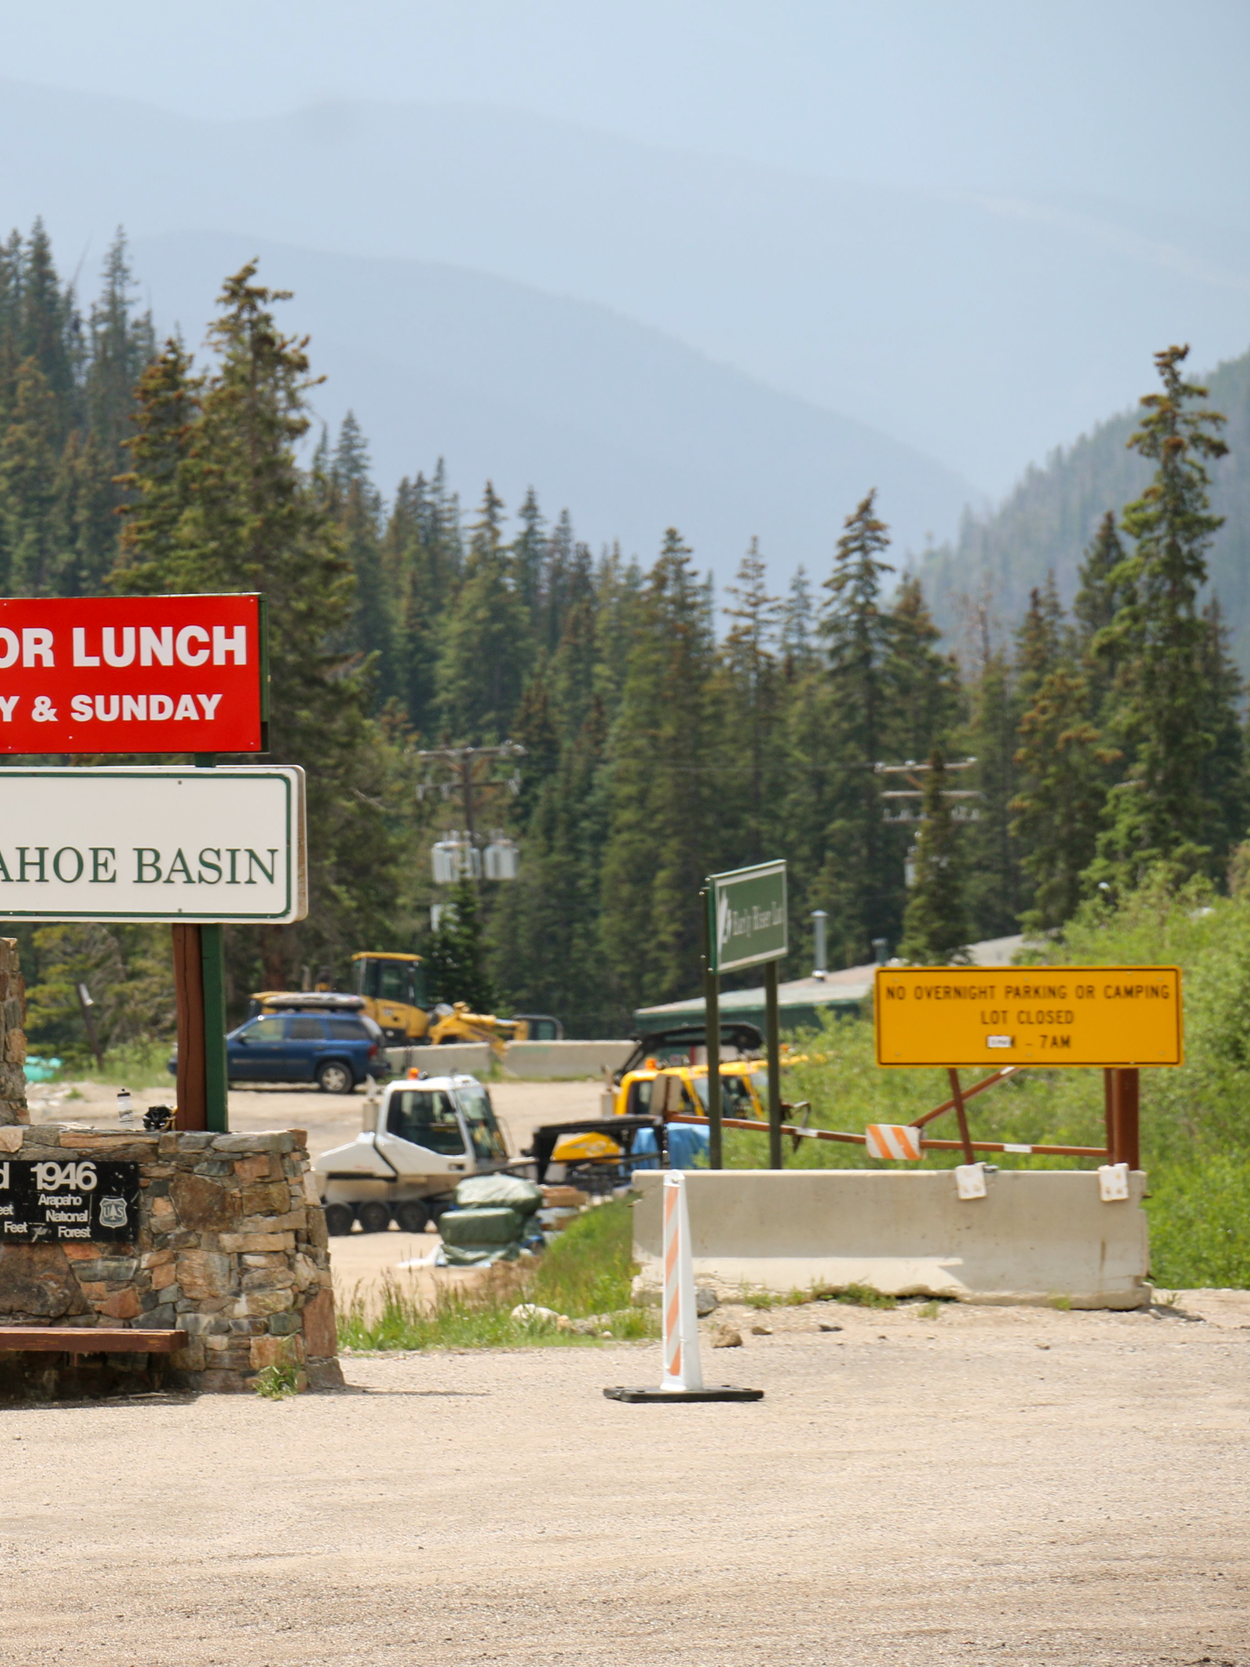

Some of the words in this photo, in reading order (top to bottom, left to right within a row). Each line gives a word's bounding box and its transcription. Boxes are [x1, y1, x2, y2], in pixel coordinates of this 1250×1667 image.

[72, 625, 247, 668] LUNCH
[31, 695, 59, 723] &
[70, 693, 223, 722] SUNDAY
[132, 847, 279, 885] BASIN
[886, 985, 906, 1000] NO
[914, 985, 996, 1000] OVERNIGHT
[1005, 985, 1067, 999] PARKING
[1076, 985, 1095, 999] OR
[1104, 984, 1170, 999] CAMPING
[981, 1010, 1008, 1025] LOT
[1017, 1010, 1075, 1025] CLOSED
[1039, 1034, 1071, 1049] 7AM
[30, 1161, 98, 1191] 1946
[38, 1193, 83, 1207] Arapaho
[46, 1209, 89, 1224] National
[4, 1220, 28, 1234] Feet
[58, 1225, 91, 1239] Forest
